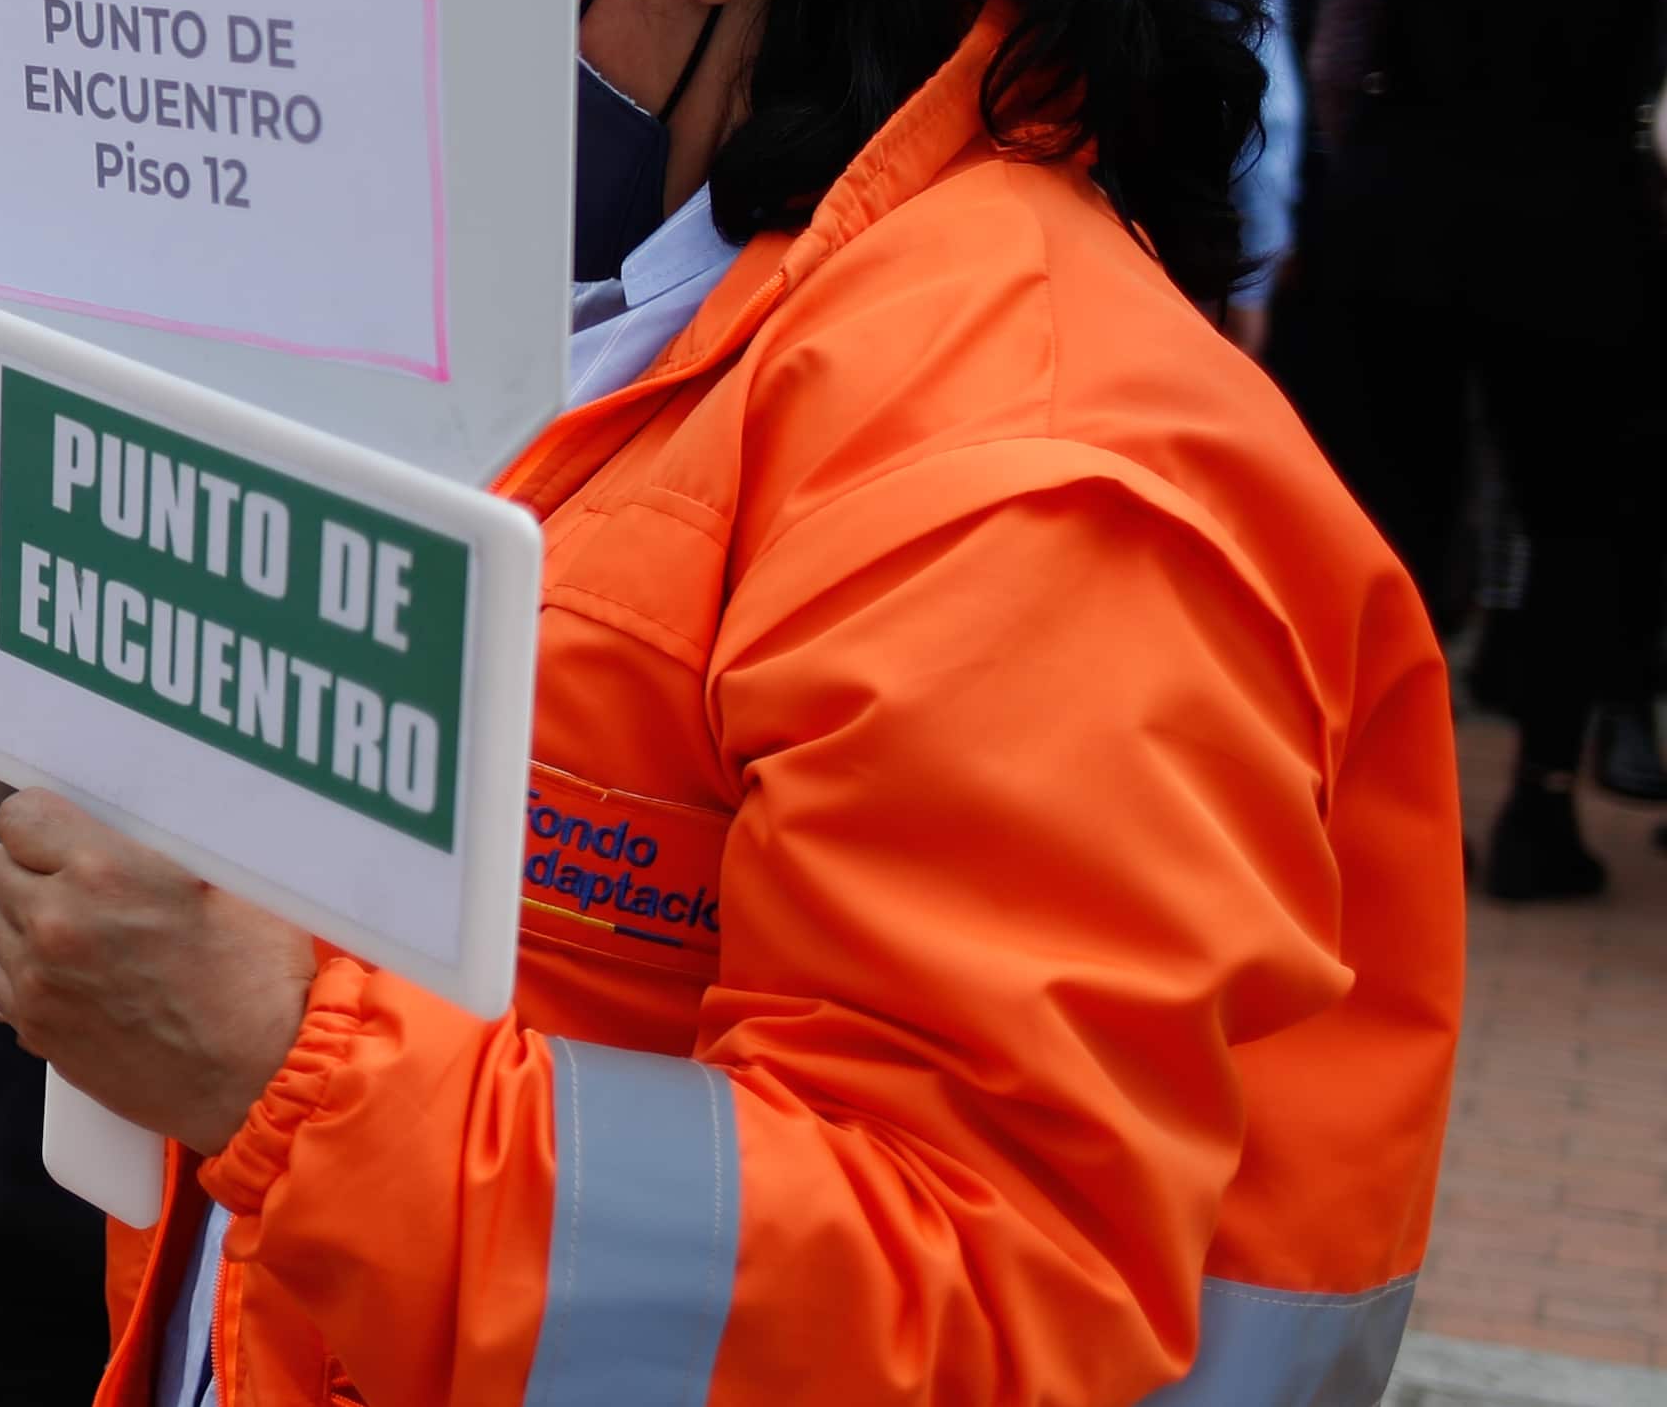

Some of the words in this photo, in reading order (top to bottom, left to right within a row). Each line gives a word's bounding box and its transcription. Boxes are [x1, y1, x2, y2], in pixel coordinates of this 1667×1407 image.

[226, 14, 297, 71] DE
[23, 63, 324, 146] ENCUENTRO
[94, 140, 193, 201] Piso
[202, 155, 251, 210] 12
[50, 412, 292, 601] PUNTO
[318, 519, 414, 653] DE
[18, 540, 441, 815] ENCUENTRO
[526, 789, 659, 869] ondo
